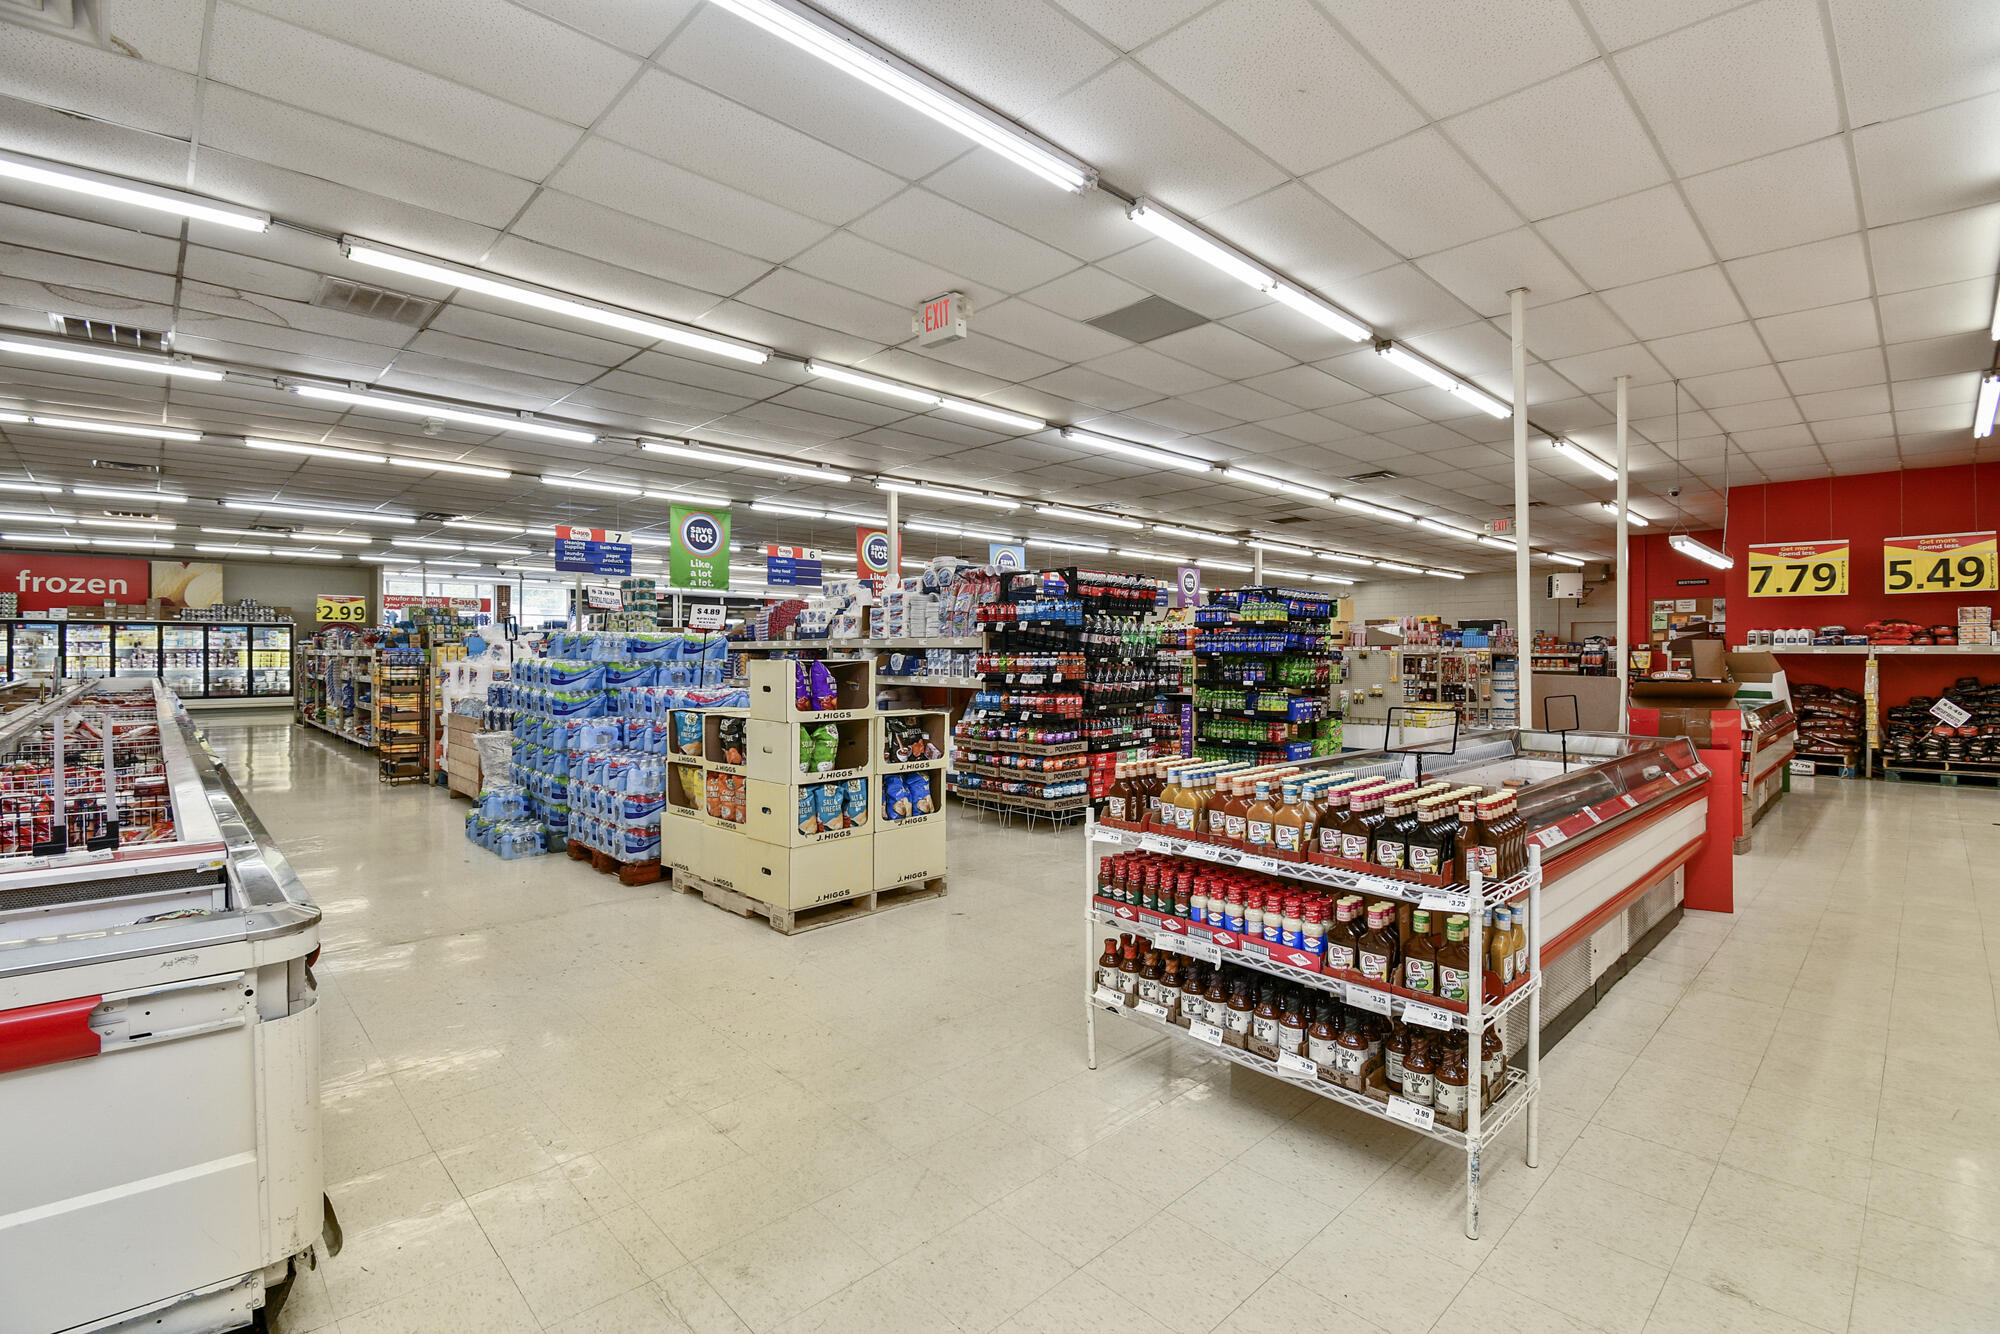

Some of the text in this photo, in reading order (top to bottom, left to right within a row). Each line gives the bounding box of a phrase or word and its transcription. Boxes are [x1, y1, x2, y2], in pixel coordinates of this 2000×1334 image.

[925, 298, 950, 333] EXIT
[690, 526, 713, 535] save
[1493, 519, 1508, 532] EXIT
[614, 533, 622, 543] 7
[695, 534, 713, 543] lot
[809, 550, 815, 559] 6
[690, 559, 713, 570] Like,
[698, 570, 712, 578] lot
[1750, 563, 1837, 593] 7.79
[1888, 556, 1985, 590] 5.49
[15, 569, 128, 595] frozen
[698, 578, 714, 587] lot.
[451, 597, 478, 606] Save
[823, 711, 852, 719] HIGGS
[1054, 743, 1083, 752] POWERADE
[826, 770, 853, 779] HIGGS
[1053, 771, 1082, 780] POWERADE
[1054, 798, 1083, 808] POWERADE
[904, 815, 928, 825] HIGGS
[824, 830, 851, 840] HIGGS
[904, 870, 928, 881] HIGGS
[823, 889, 850, 901] HIGGS
